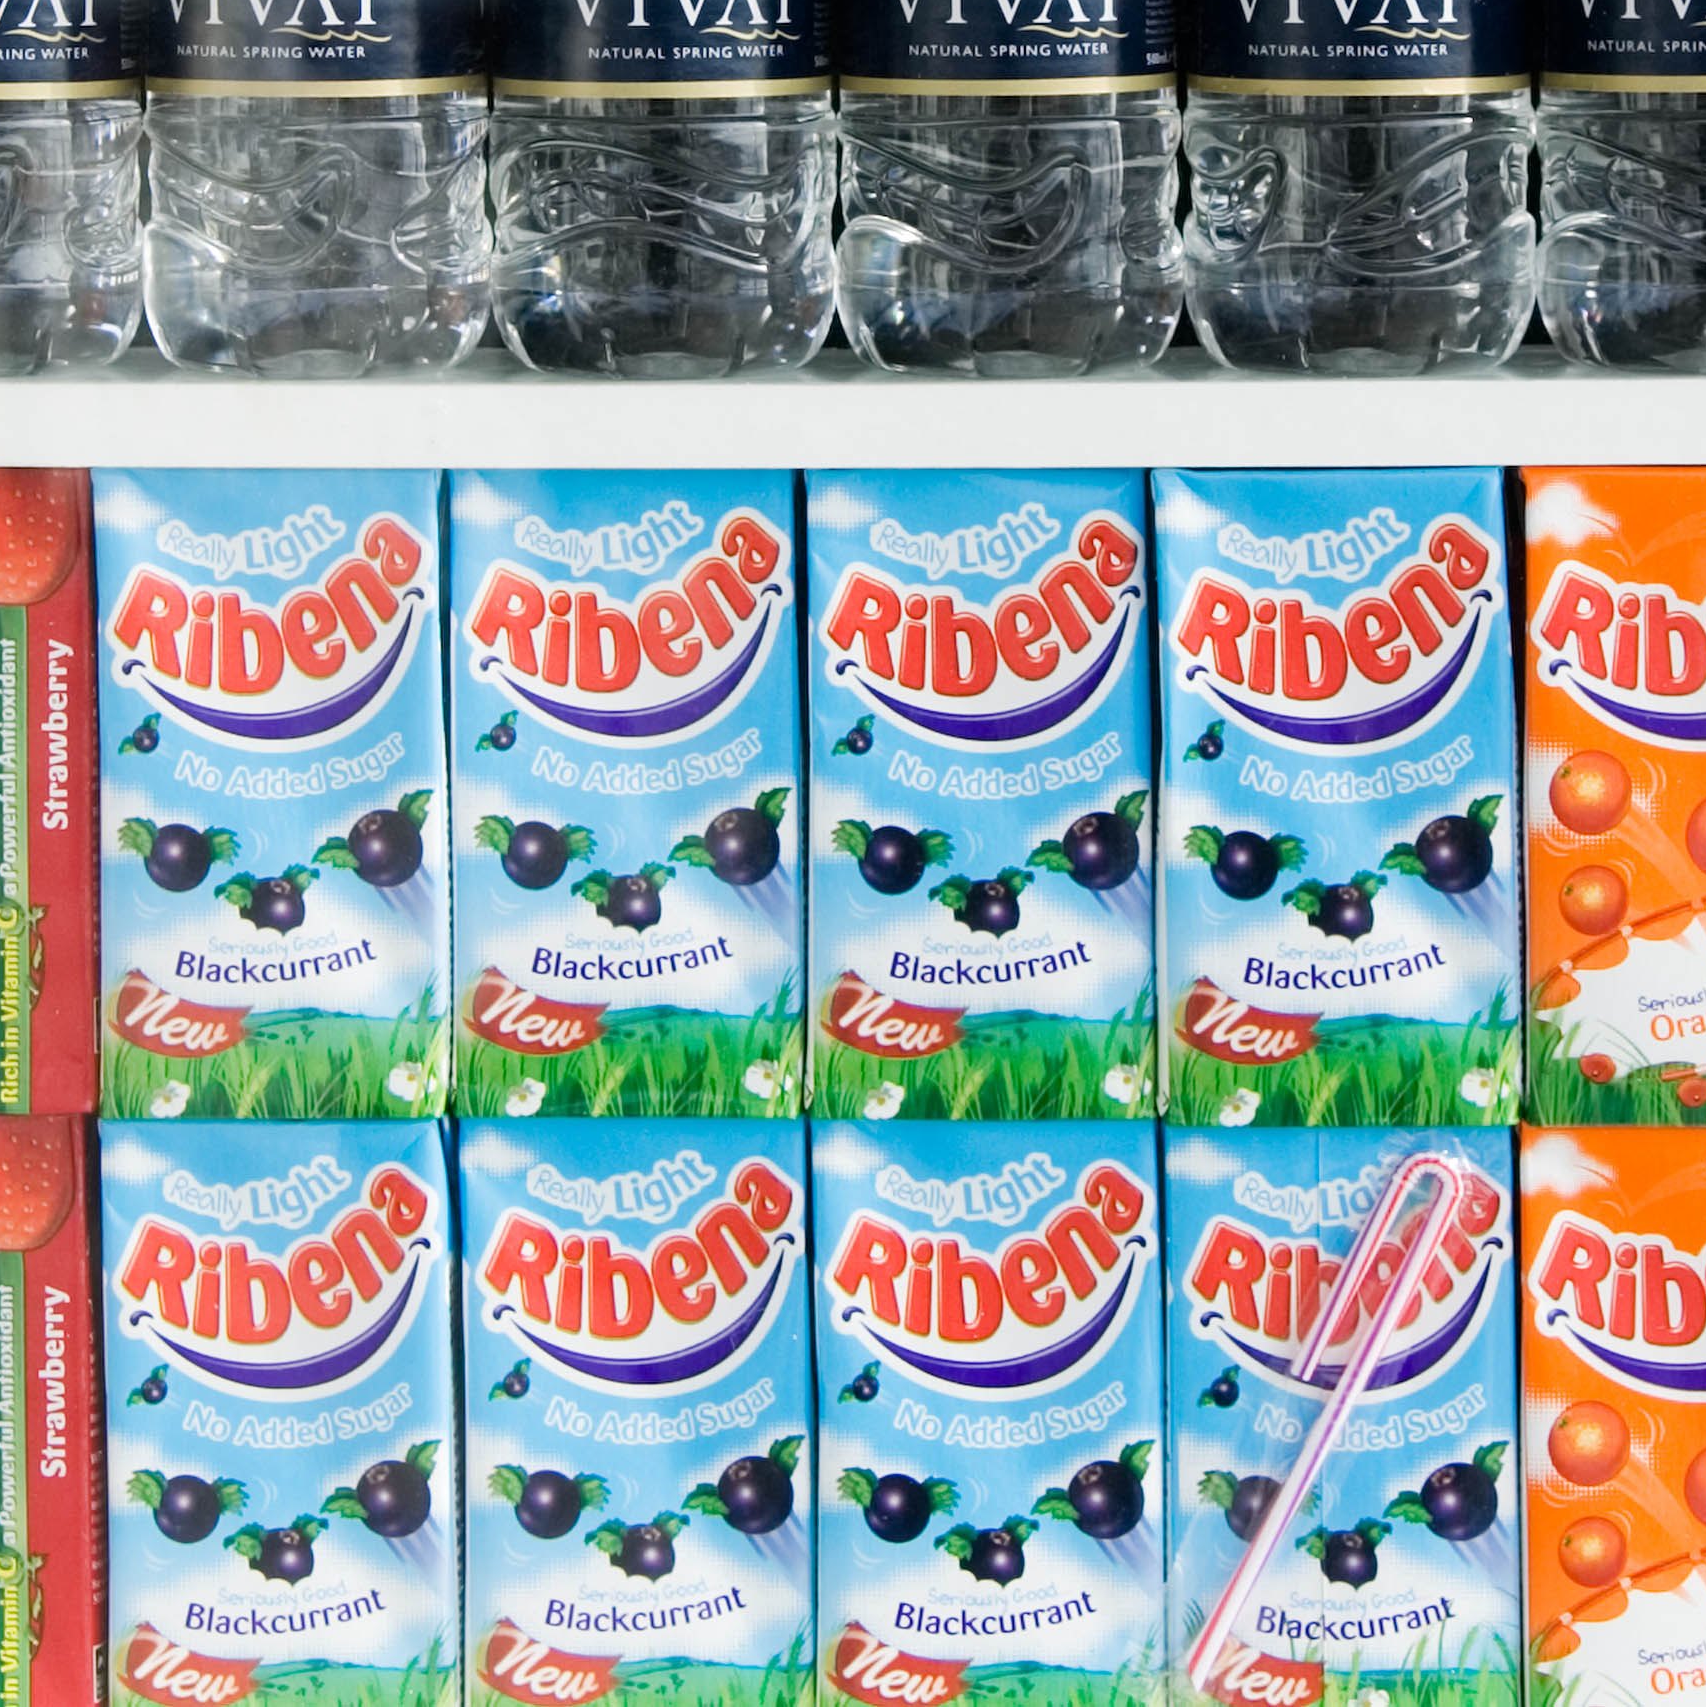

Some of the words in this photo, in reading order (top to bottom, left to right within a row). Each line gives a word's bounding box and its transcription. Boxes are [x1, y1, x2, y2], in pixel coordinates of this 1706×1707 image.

[41, 48, 87, 59] WATER
[588, 46, 666, 61] NATURAL
[673, 46, 732, 59] SPRING
[737, 45, 782, 57] WATER
[909, 45, 982, 57] NATURAL
[990, 44, 1050, 56] SPRING
[1057, 43, 1108, 55] WATER
[1249, 45, 1319, 57] NATURAL
[1327, 45, 1388, 57] SPRING
[1395, 44, 1448, 56] WATER
[1588, 40, 1655, 52] NATURAL
[165, 527, 236, 574] Really
[245, 507, 339, 568] Light
[114, 518, 422, 694] Ribena
[42, 640, 75, 829] Strawberry
[176, 755, 220, 790] No
[228, 761, 324, 795] Added
[332, 734, 404, 790] Sugar
[0, 771, 18, 877] Powerful
[5, 882, 18, 895] a
[175, 941, 377, 983] Blackcurrant
[0, 1017, 17, 1036] in
[125, 985, 229, 1050] New
[0, 1043, 17, 1103] Rich
[885, 1175, 954, 1221] Really
[962, 1156, 1060, 1215] Light
[834, 1166, 1145, 1341] Ribena
[896, 1405, 939, 1441] No
[946, 1412, 1040, 1446] Added
[1048, 1386, 1126, 1441] Sugar
[894, 1591, 1096, 1635] Blackcurrant
[846, 1642, 946, 1703] New
